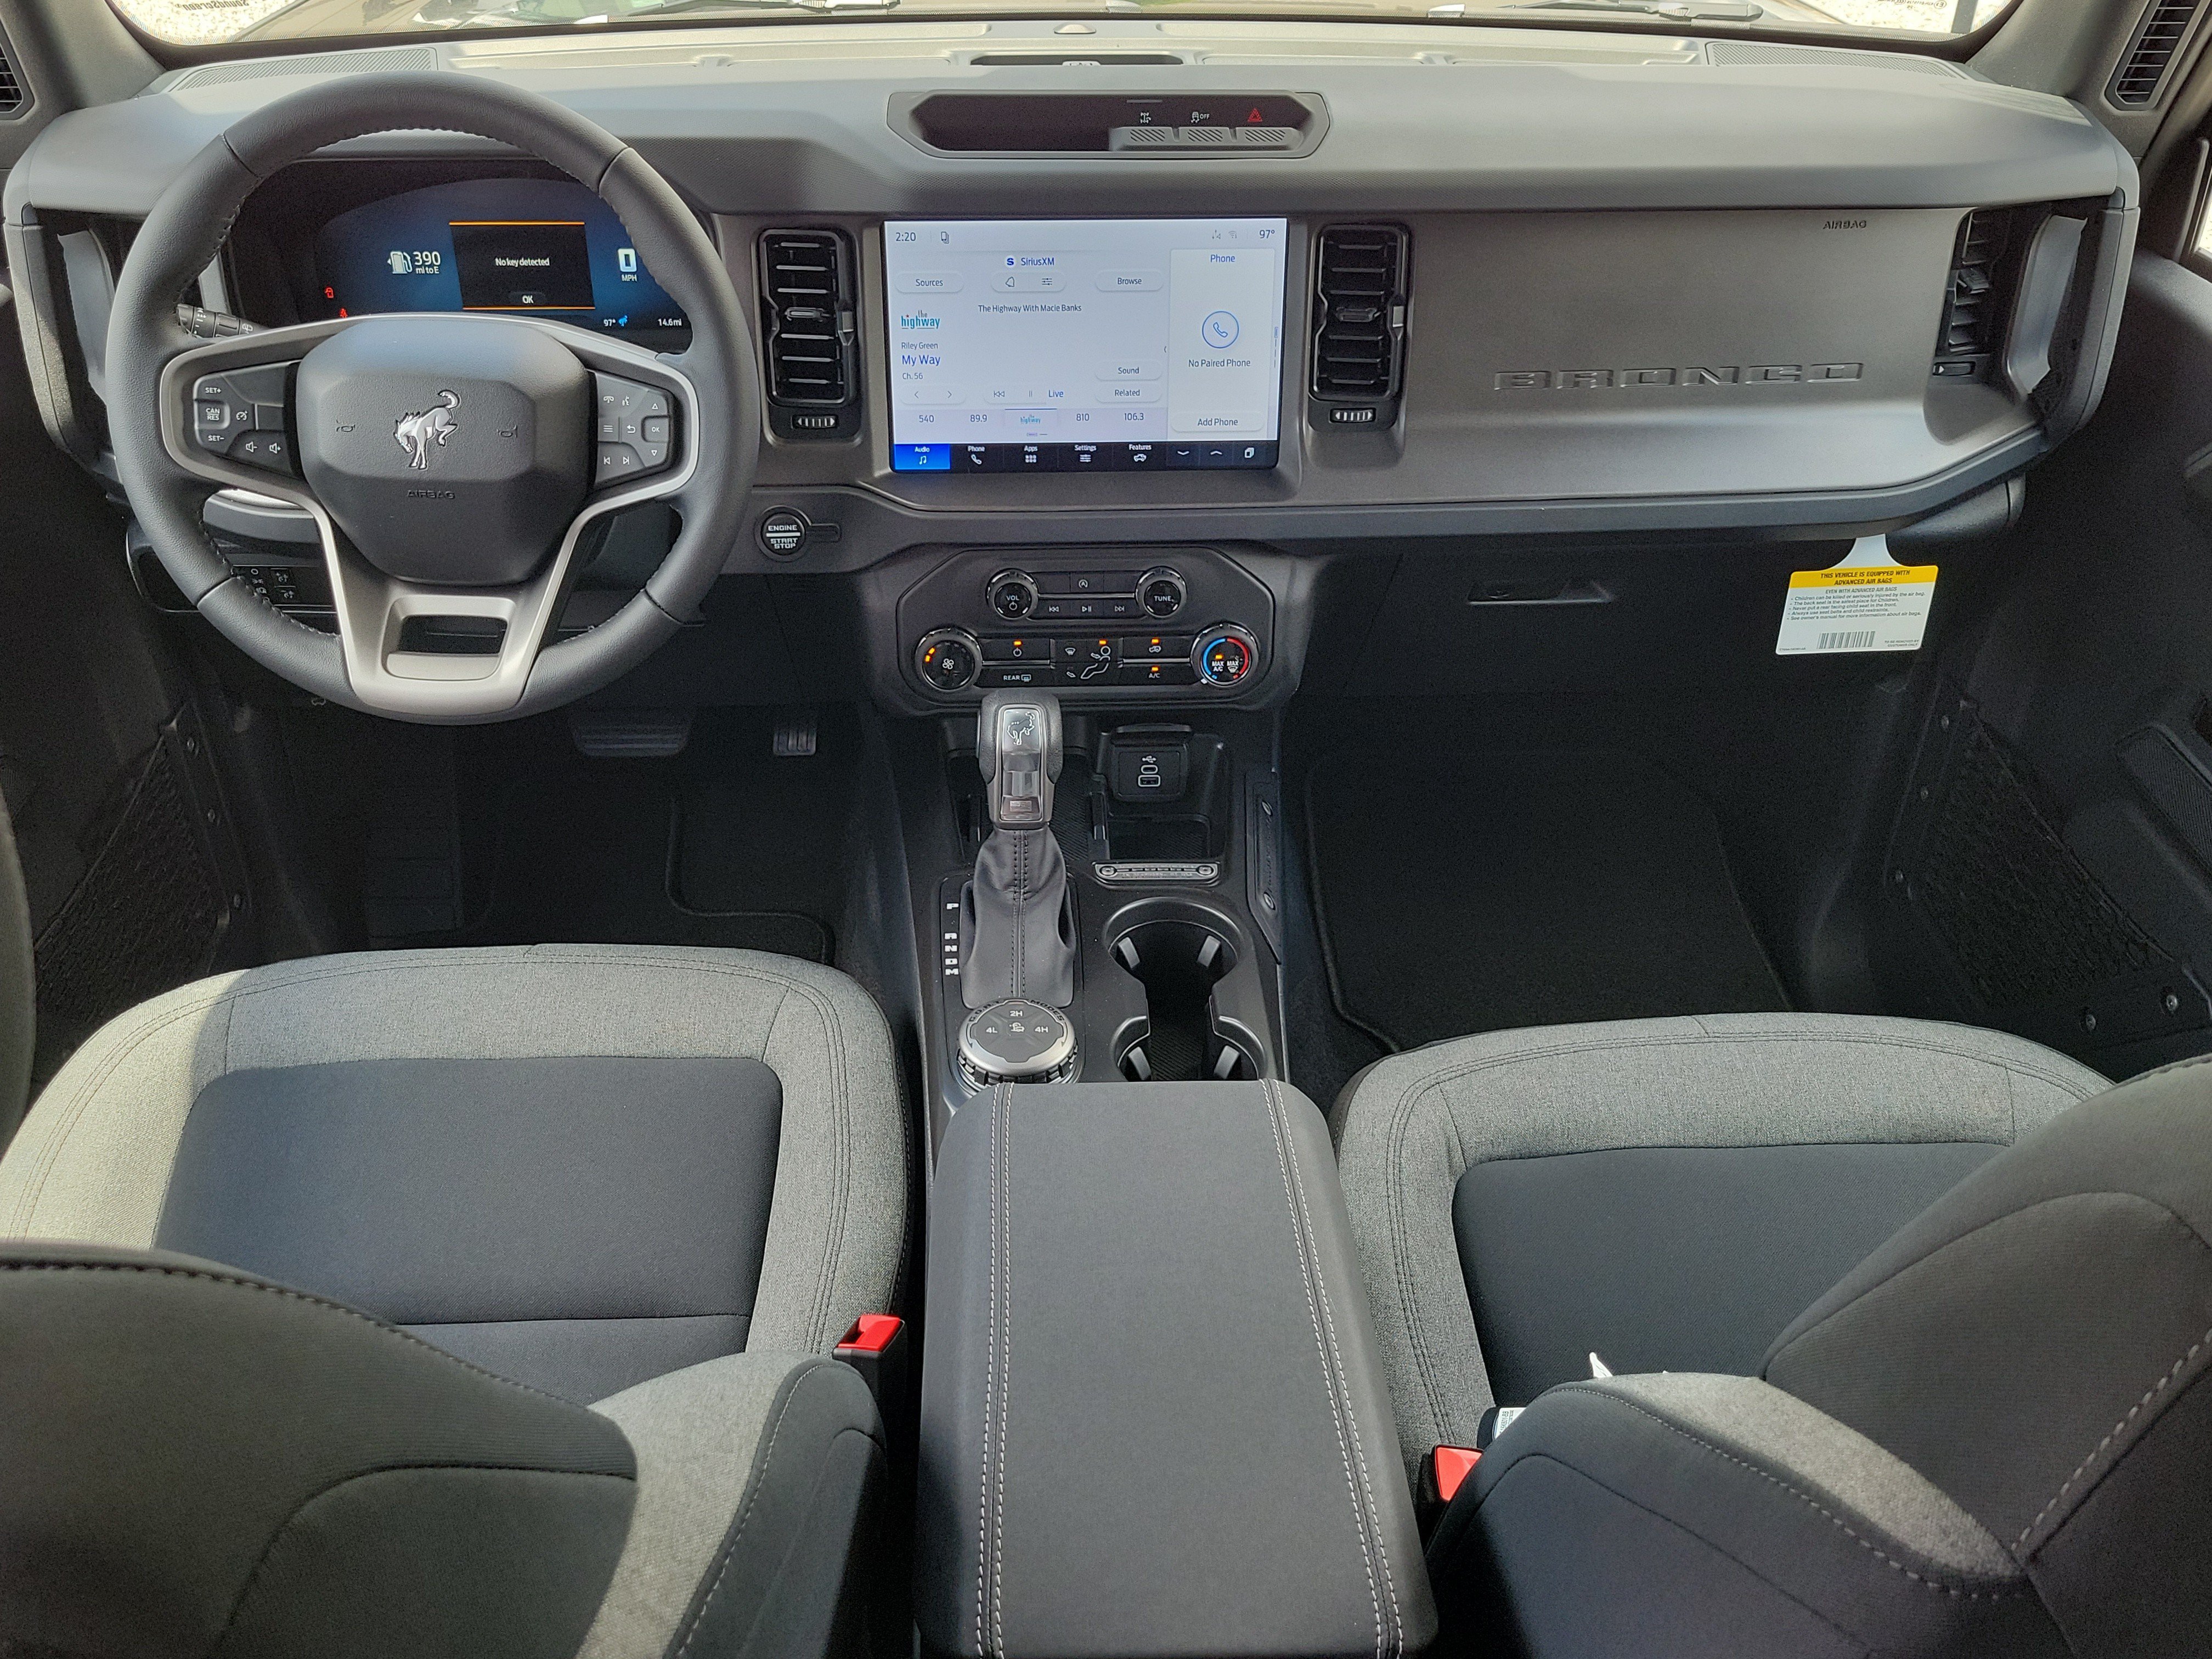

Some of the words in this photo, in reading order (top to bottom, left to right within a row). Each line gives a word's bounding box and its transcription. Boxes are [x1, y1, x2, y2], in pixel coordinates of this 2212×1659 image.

[1823, 219, 1866, 230] AIRBAG
[896, 232, 916, 241] 2:20
[1259, 229, 1275, 239] 97°
[413, 251, 441, 266] 390
[506, 258, 518, 268] key
[519, 257, 550, 266] detected
[618, 248, 637, 272] 0
[1021, 257, 1055, 266] SiriusXM
[1210, 254, 1235, 262] Phone
[522, 295, 534, 304] OK
[918, 309, 927, 318] the
[992, 304, 1022, 313] Highway
[901, 314, 940, 329] highway
[902, 355, 916, 366] My
[919, 355, 941, 366] Way
[1494, 363, 1864, 390] BRONCO
[1048, 390, 1064, 398] Live
[919, 415, 934, 423] 540
[970, 414, 988, 422] 89.9
[406, 490, 455, 500] AIRBAG
[1030, 1000, 1065, 1021] MODES
